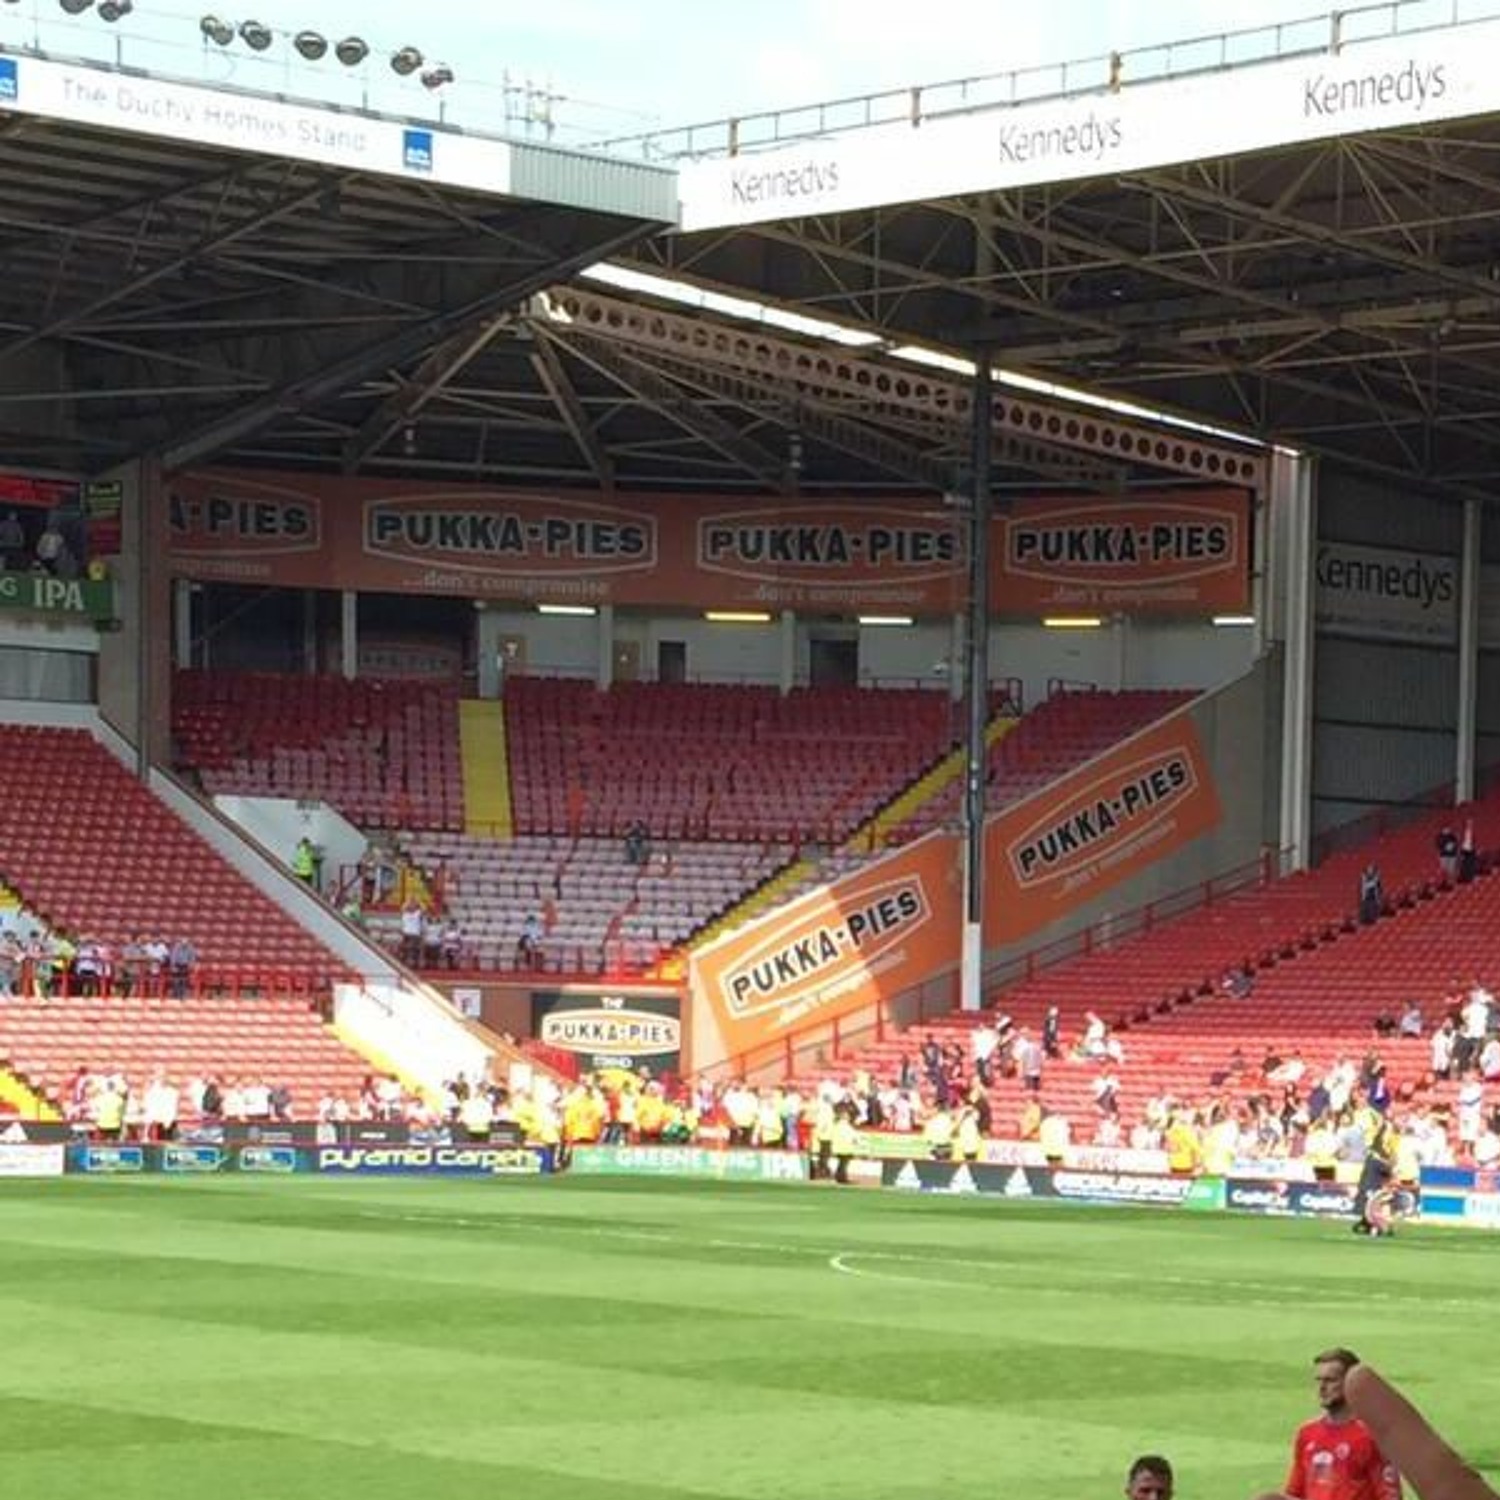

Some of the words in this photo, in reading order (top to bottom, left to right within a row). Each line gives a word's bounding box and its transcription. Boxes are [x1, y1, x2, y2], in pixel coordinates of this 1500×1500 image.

[62, 78, 107, 104] The
[117, 87, 194, 121] Duchy
[205, 106, 289, 139] Homes
[1303, 59, 1446, 116] Kennedys
[1000, 113, 1122, 162] Kennedys
[730, 160, 840, 204] Kennedys
[33, 578, 85, 611] IPA
[319, 1148, 432, 1169] pyramid
